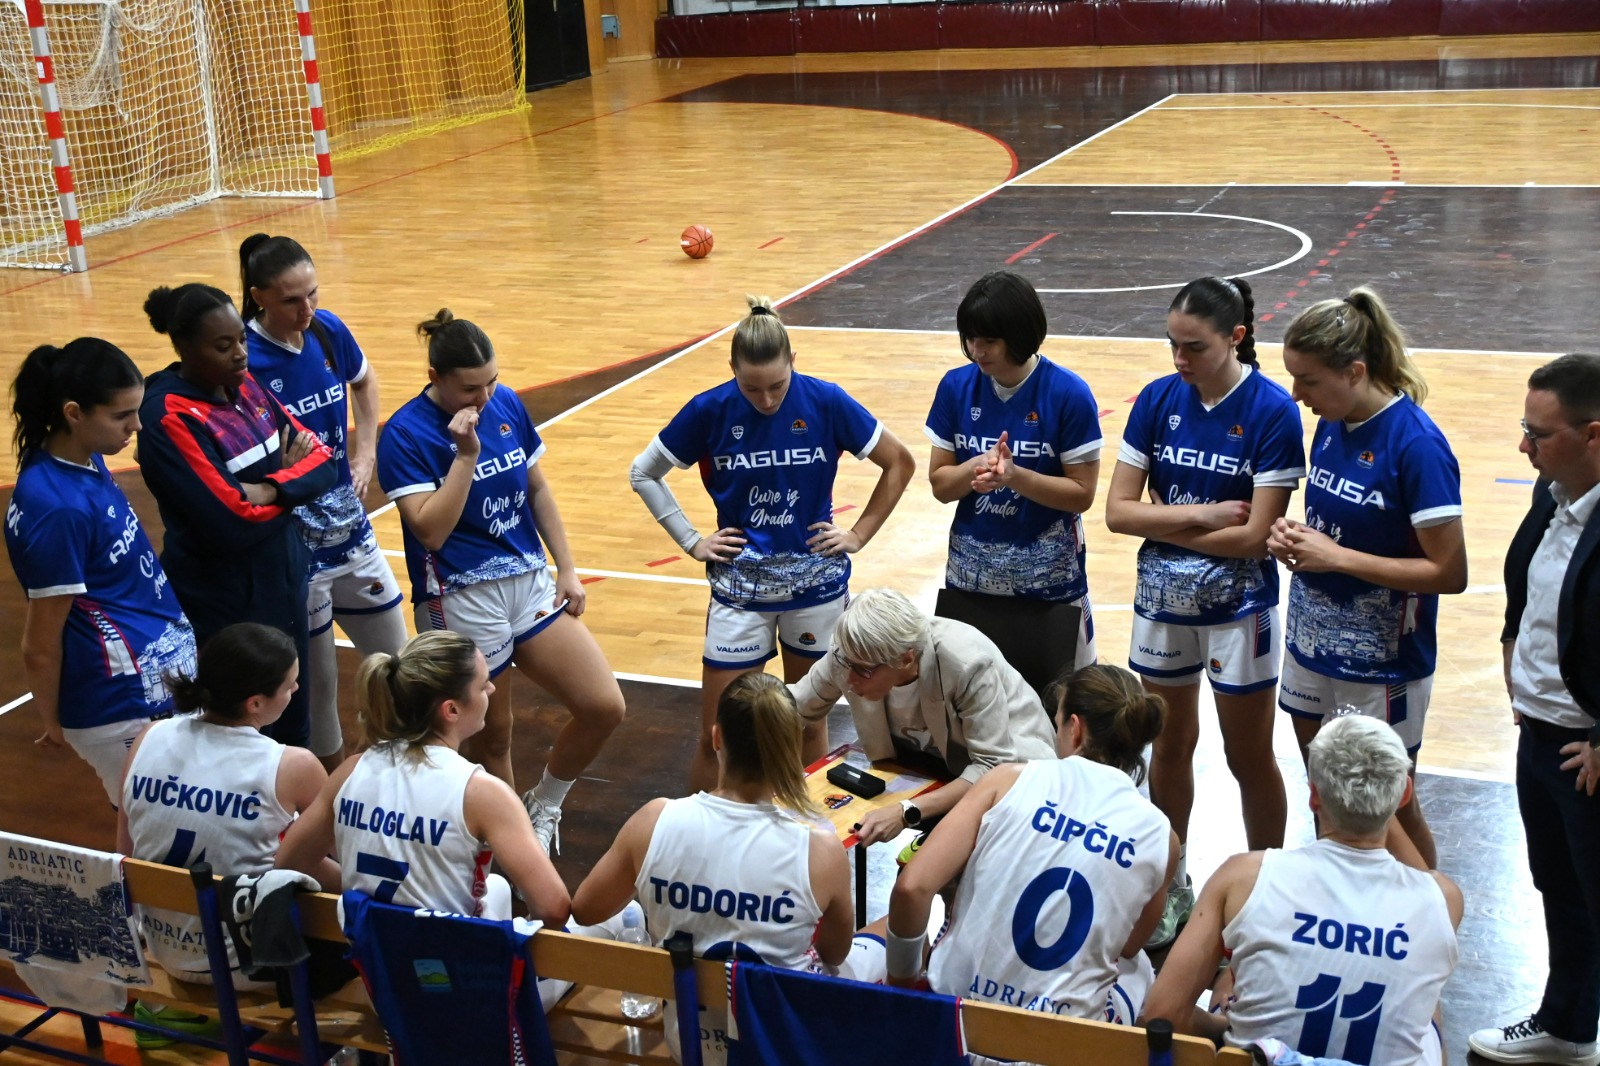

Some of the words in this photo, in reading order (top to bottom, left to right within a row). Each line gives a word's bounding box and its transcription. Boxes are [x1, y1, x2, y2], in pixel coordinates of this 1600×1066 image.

[714, 447, 827, 471] RAGUSA
[749, 485, 782, 507] Cure
[1308, 466, 1386, 510] AGUSA
[716, 644, 760, 654] VALAMAR
[1138, 645, 1182, 659] VALAMAR
[132, 775, 261, 820] VUČKOVIĆ
[338, 798, 448, 847] MILOGLAV
[1031, 800, 1136, 869] ČIPČIĆ
[8, 846, 85, 874] ADRIATIC
[356, 852, 409, 904] 7
[650, 876, 795, 924] TODORIĆ
[1012, 867, 1094, 971] 0
[144, 915, 204, 945] ADRIAT
[1291, 912, 1410, 961] ZORIĆ
[1295, 973, 1386, 1066] 11
